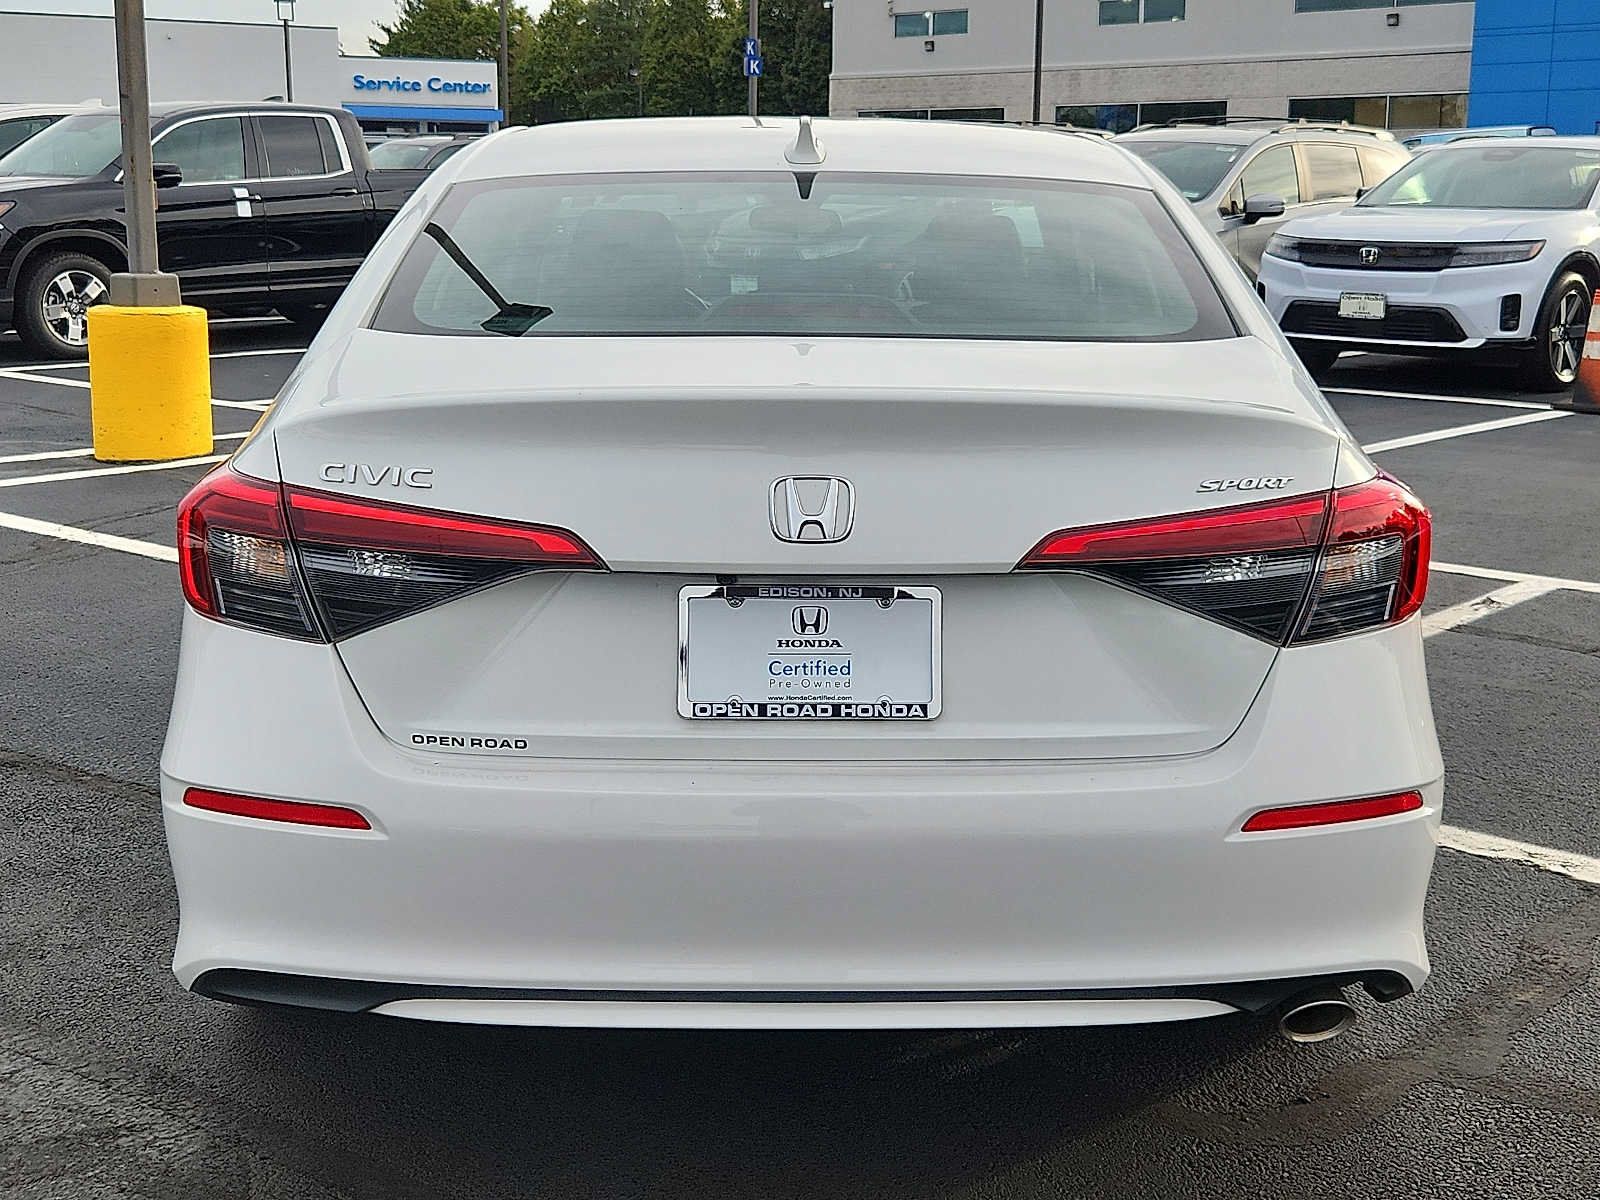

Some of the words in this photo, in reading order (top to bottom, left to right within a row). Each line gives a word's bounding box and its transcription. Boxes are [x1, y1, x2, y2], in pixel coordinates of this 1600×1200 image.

[746, 41, 755, 56] K
[750, 60, 760, 74] K
[353, 74, 422, 92] Service
[427, 77, 491, 93] Center
[319, 463, 434, 488] CIVIC
[1196, 476, 1295, 493] SPORT
[758, 587, 832, 598] EDISON,
[839, 588, 863, 598] NJ
[776, 639, 844, 648] HONDA
[768, 660, 852, 677] Certified
[769, 678, 852, 689] Pre-Owned
[694, 703, 759, 717] OPEN
[766, 703, 833, 717] ROAD
[840, 704, 925, 718] HONDA
[411, 734, 465, 747] OPEN
[470, 738, 528, 750] ROAD
